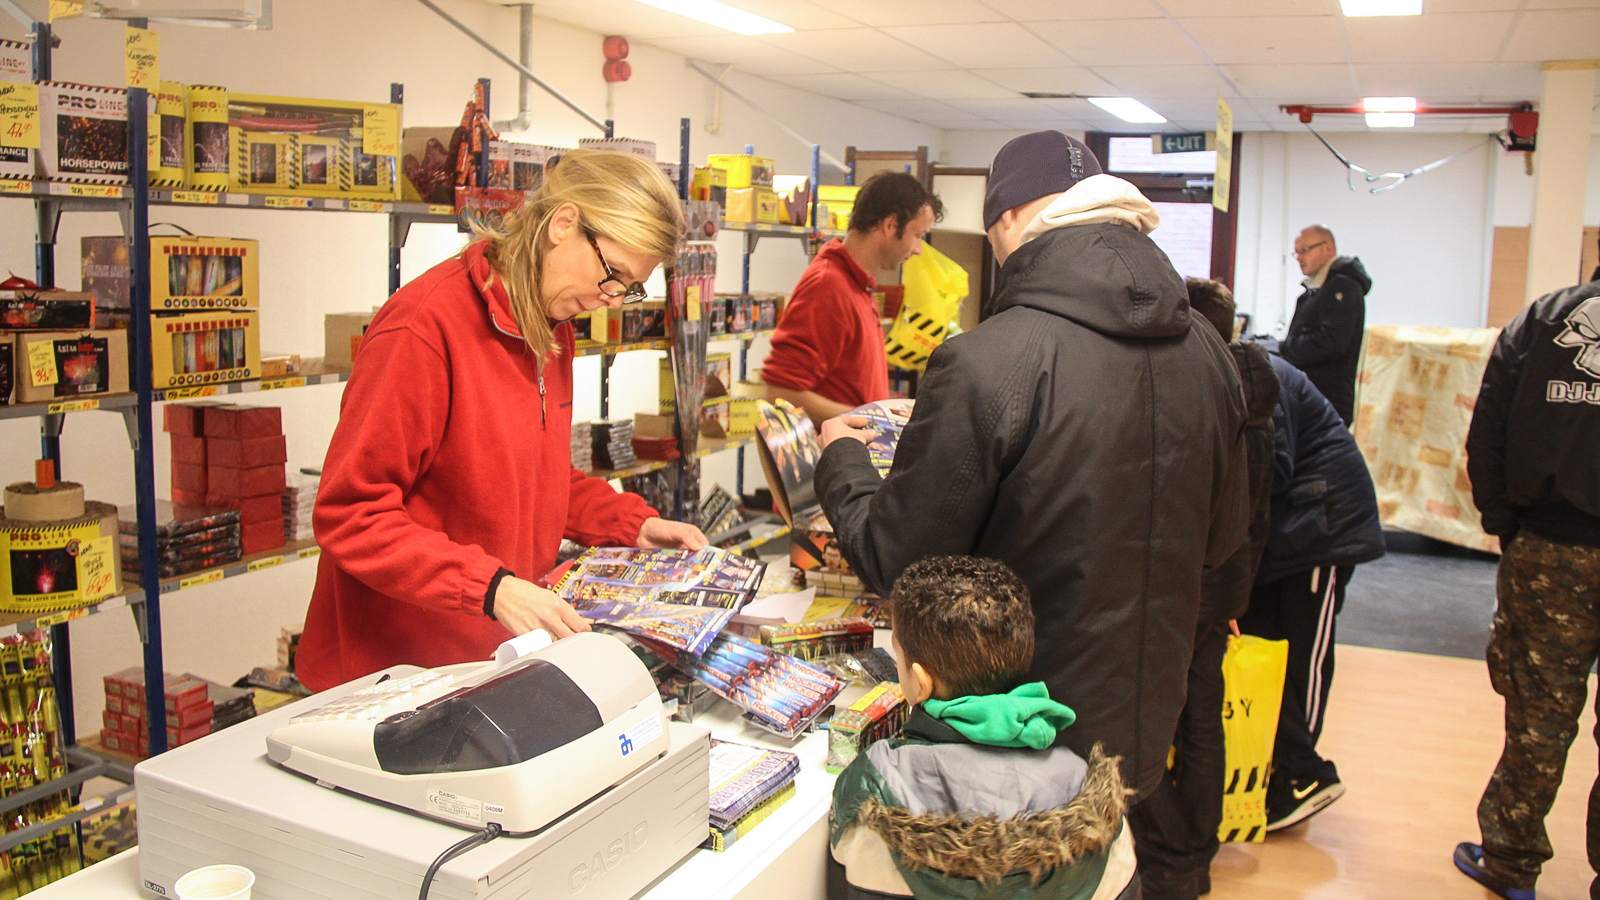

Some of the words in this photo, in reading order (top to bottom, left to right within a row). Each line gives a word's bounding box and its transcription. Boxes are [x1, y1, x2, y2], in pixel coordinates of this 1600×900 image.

[57, 94, 97, 110] PRO
[191, 101, 217, 109] PRO
[1178, 135, 1202, 151] UIT
[60, 157, 128, 170] HORSEPOWER
[10, 532, 41, 542] PRO
[438, 789, 457, 800] CASIO
[567, 820, 649, 891] CASIO
